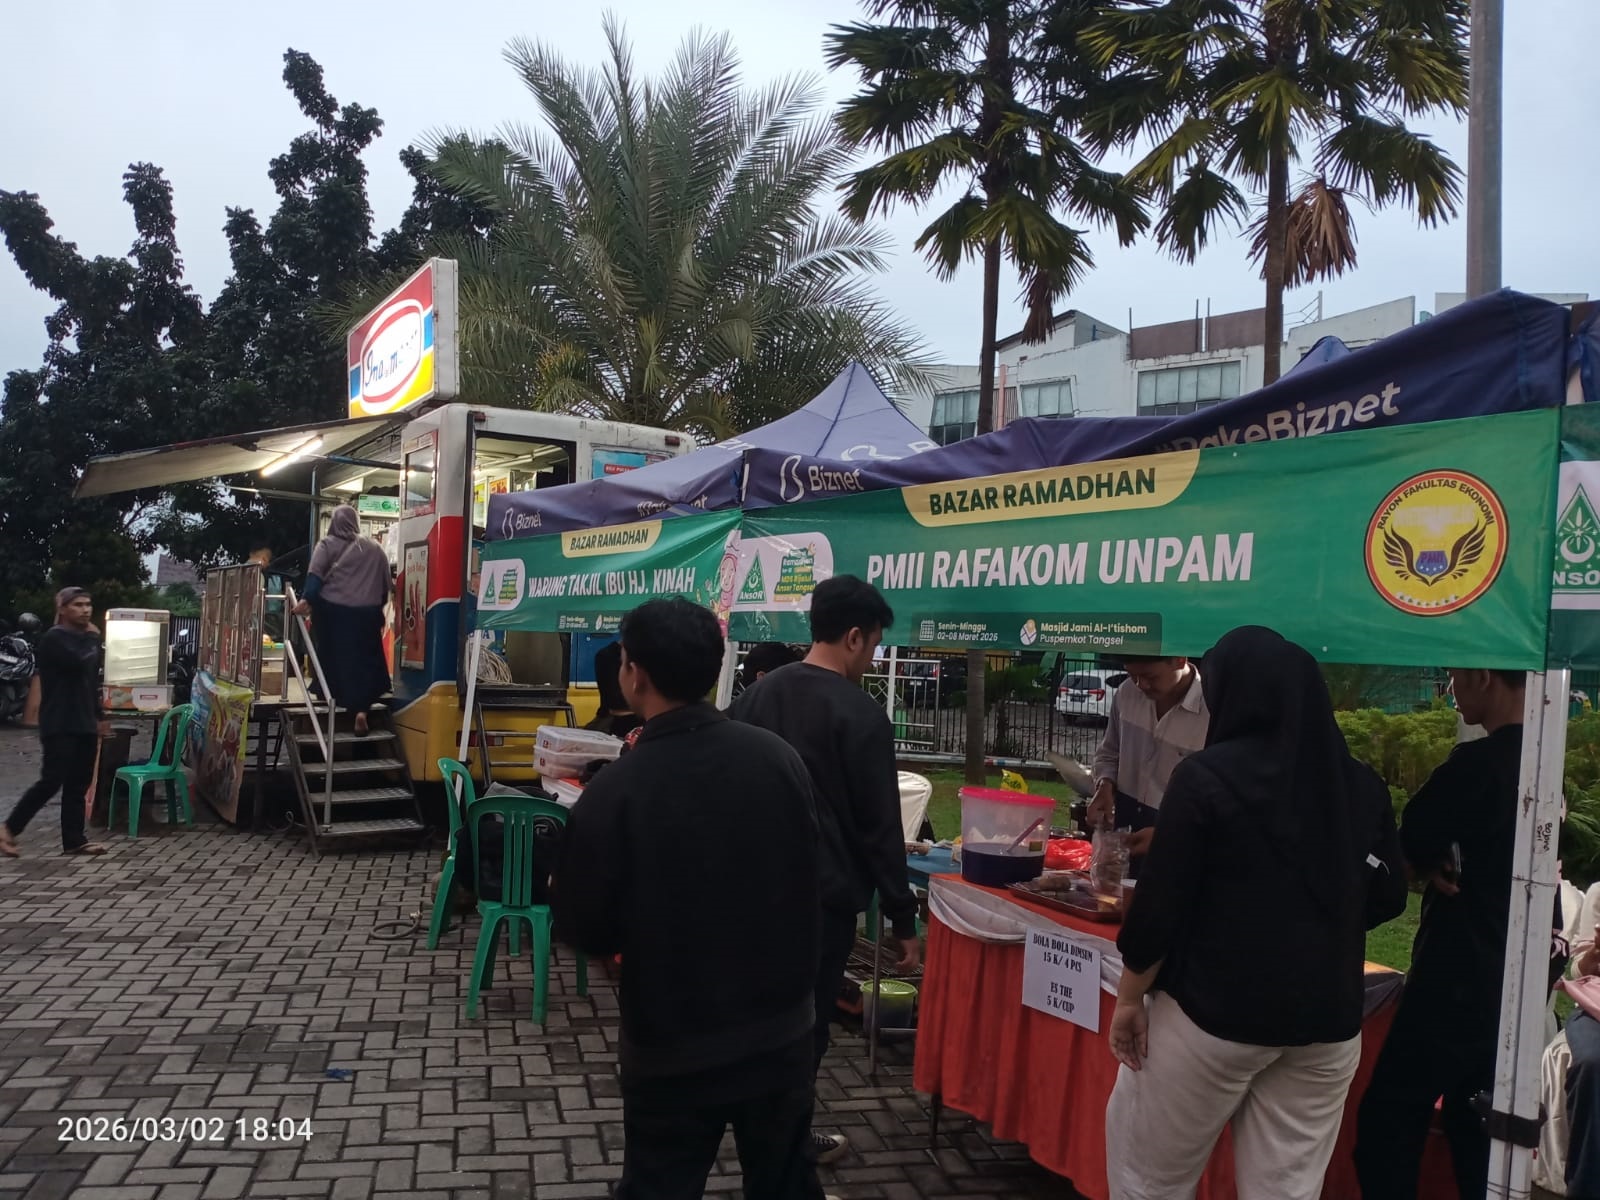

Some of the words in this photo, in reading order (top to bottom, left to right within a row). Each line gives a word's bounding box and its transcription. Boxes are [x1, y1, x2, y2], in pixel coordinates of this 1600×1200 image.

[1158, 381, 1401, 450] PakeBiznet
[808, 465, 864, 492] Biznet
[929, 487, 999, 516] BAZAR
[1003, 468, 1156, 507] RAMADHAN
[1377, 497, 1403, 529] RAYON
[1403, 479, 1457, 498] FAKULTAS
[1459, 484, 1495, 525] EKONOMI
[515, 510, 542, 530] Biznet
[570, 535, 597, 551] BAZAR
[598, 528, 649, 547] RAMADHAN
[867, 552, 925, 590] PMII
[931, 542, 1089, 588] RAFAKOM
[1098, 532, 1255, 584] UNPAM
[528, 574, 568, 598] WARUNG
[567, 571, 603, 597] TAKJIL
[605, 570, 626, 595] IBU
[628, 569, 649, 594] HJ.
[653, 566, 697, 594] KINAH
[1553, 570, 1600, 586] NSO
[740, 590, 763, 600] ANSOR
[937, 632, 957, 641] 02-08
[959, 632, 979, 641] Maret
[980, 632, 998, 642] 2026
[938, 621, 987, 633] Senin-Minggu
[1040, 622, 1069, 634] Masjid
[1070, 622, 1093, 633] Jami
[1040, 634, 1087, 645] Puspemkot
[1088, 634, 1124, 648] Tangsel
[1033, 933, 1050, 948] BOLA
[1051, 938, 1069, 954] BOLA
[1070, 945, 1093, 962] DIMSUM
[1043, 951, 1052, 962] 15
[1064, 958, 1069, 969] 4
[1070, 960, 1082, 973] PCS
[1047, 995, 1052, 1006] 5
[1050, 981, 1058, 994] ES
[1060, 985, 1073, 999] THE
